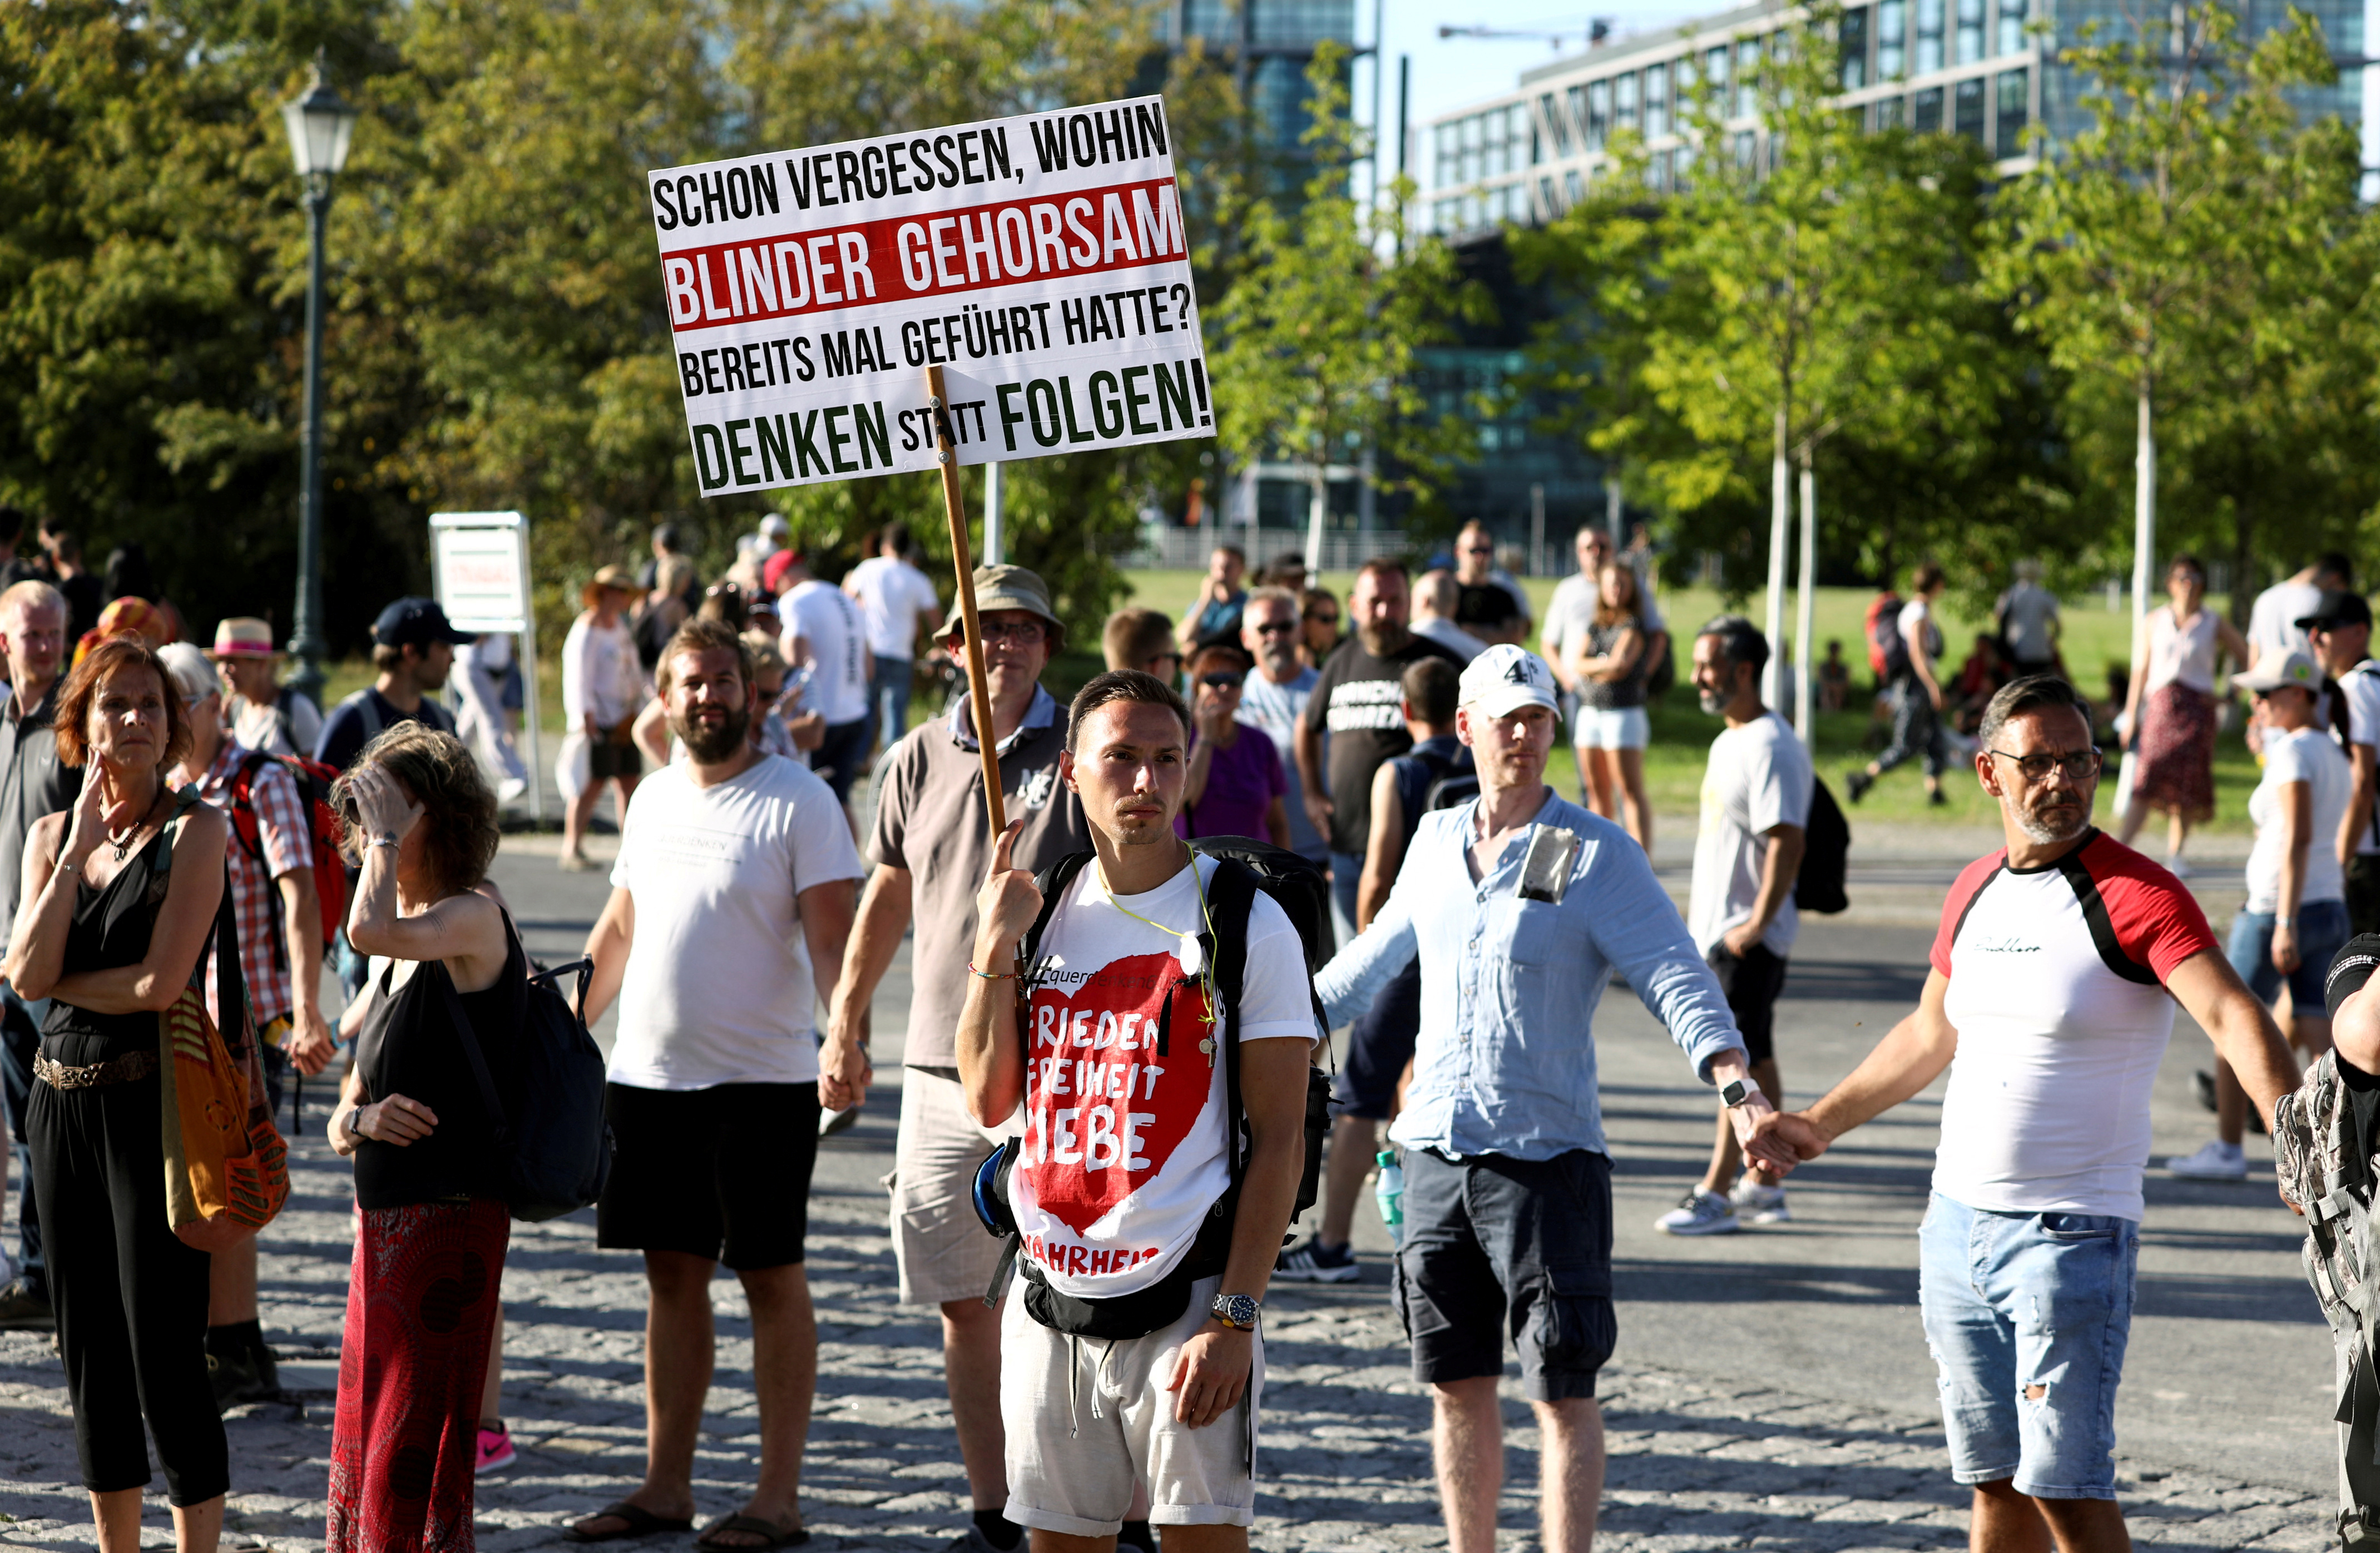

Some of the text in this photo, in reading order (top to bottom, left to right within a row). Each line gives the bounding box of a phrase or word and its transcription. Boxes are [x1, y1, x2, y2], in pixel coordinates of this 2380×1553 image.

[654, 102, 1167, 231] SCHON VERGESSEN, WOHIN
[669, 184, 1182, 325] BLINDER GEHORSAM
[680, 283, 1191, 398] BEREITS MAL GEFÜHRT HATTE?
[692, 401, 893, 490] DENKEN
[994, 358, 1211, 451] FOLGEN!
[1026, 1234, 1159, 1278] AHRHEIT
